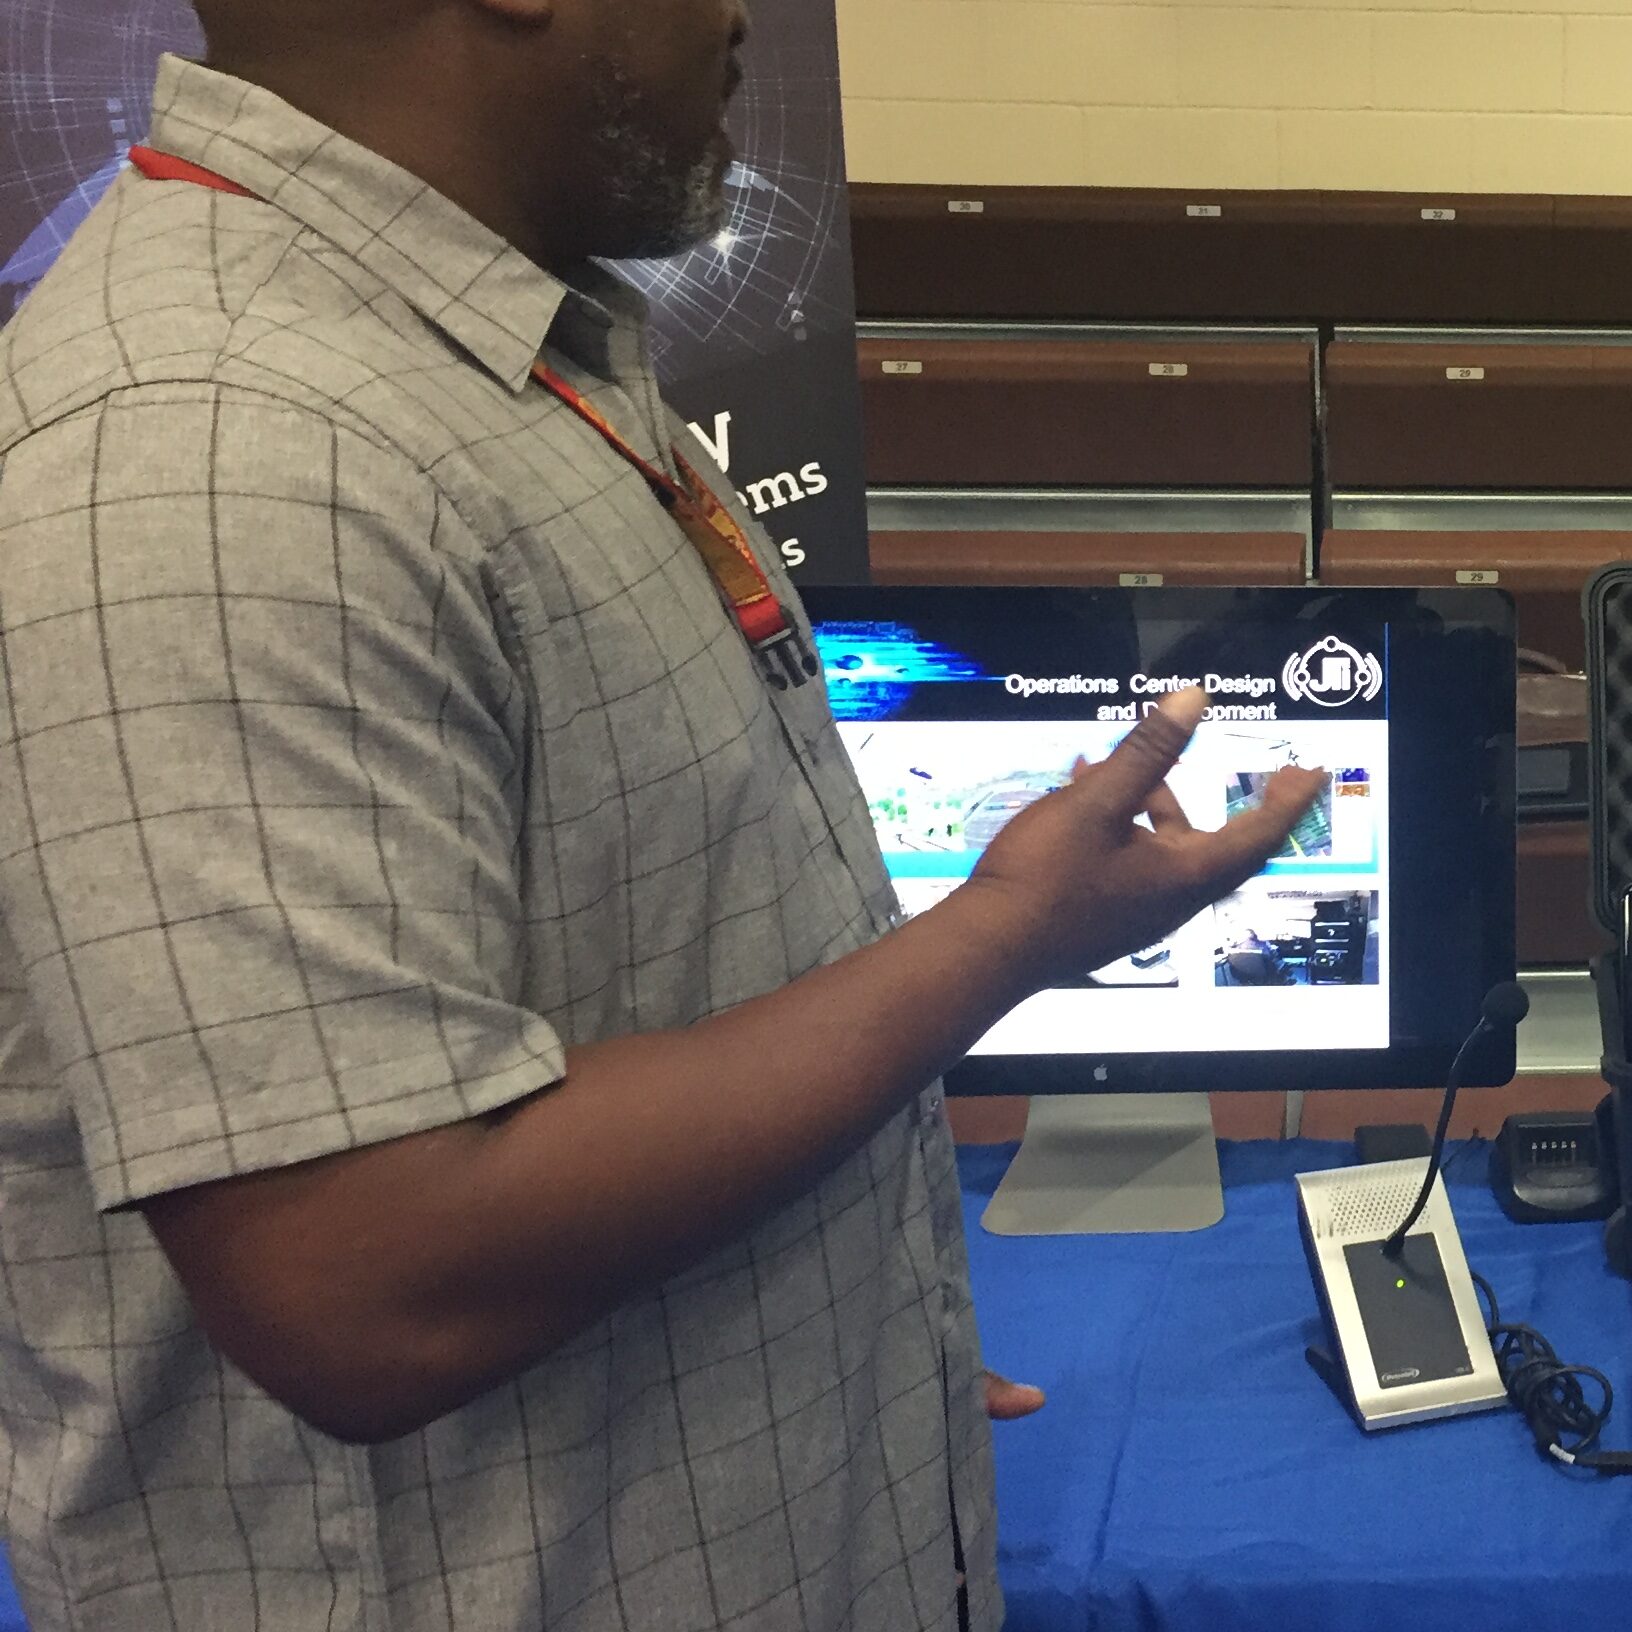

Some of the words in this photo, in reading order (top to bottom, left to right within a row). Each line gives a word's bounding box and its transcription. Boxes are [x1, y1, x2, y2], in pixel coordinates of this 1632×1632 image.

[736, 462, 828, 514] ms
[1005, 673, 1119, 697] Operations
[1204, 674, 1276, 697] Design
[1097, 702, 1136, 720] and
